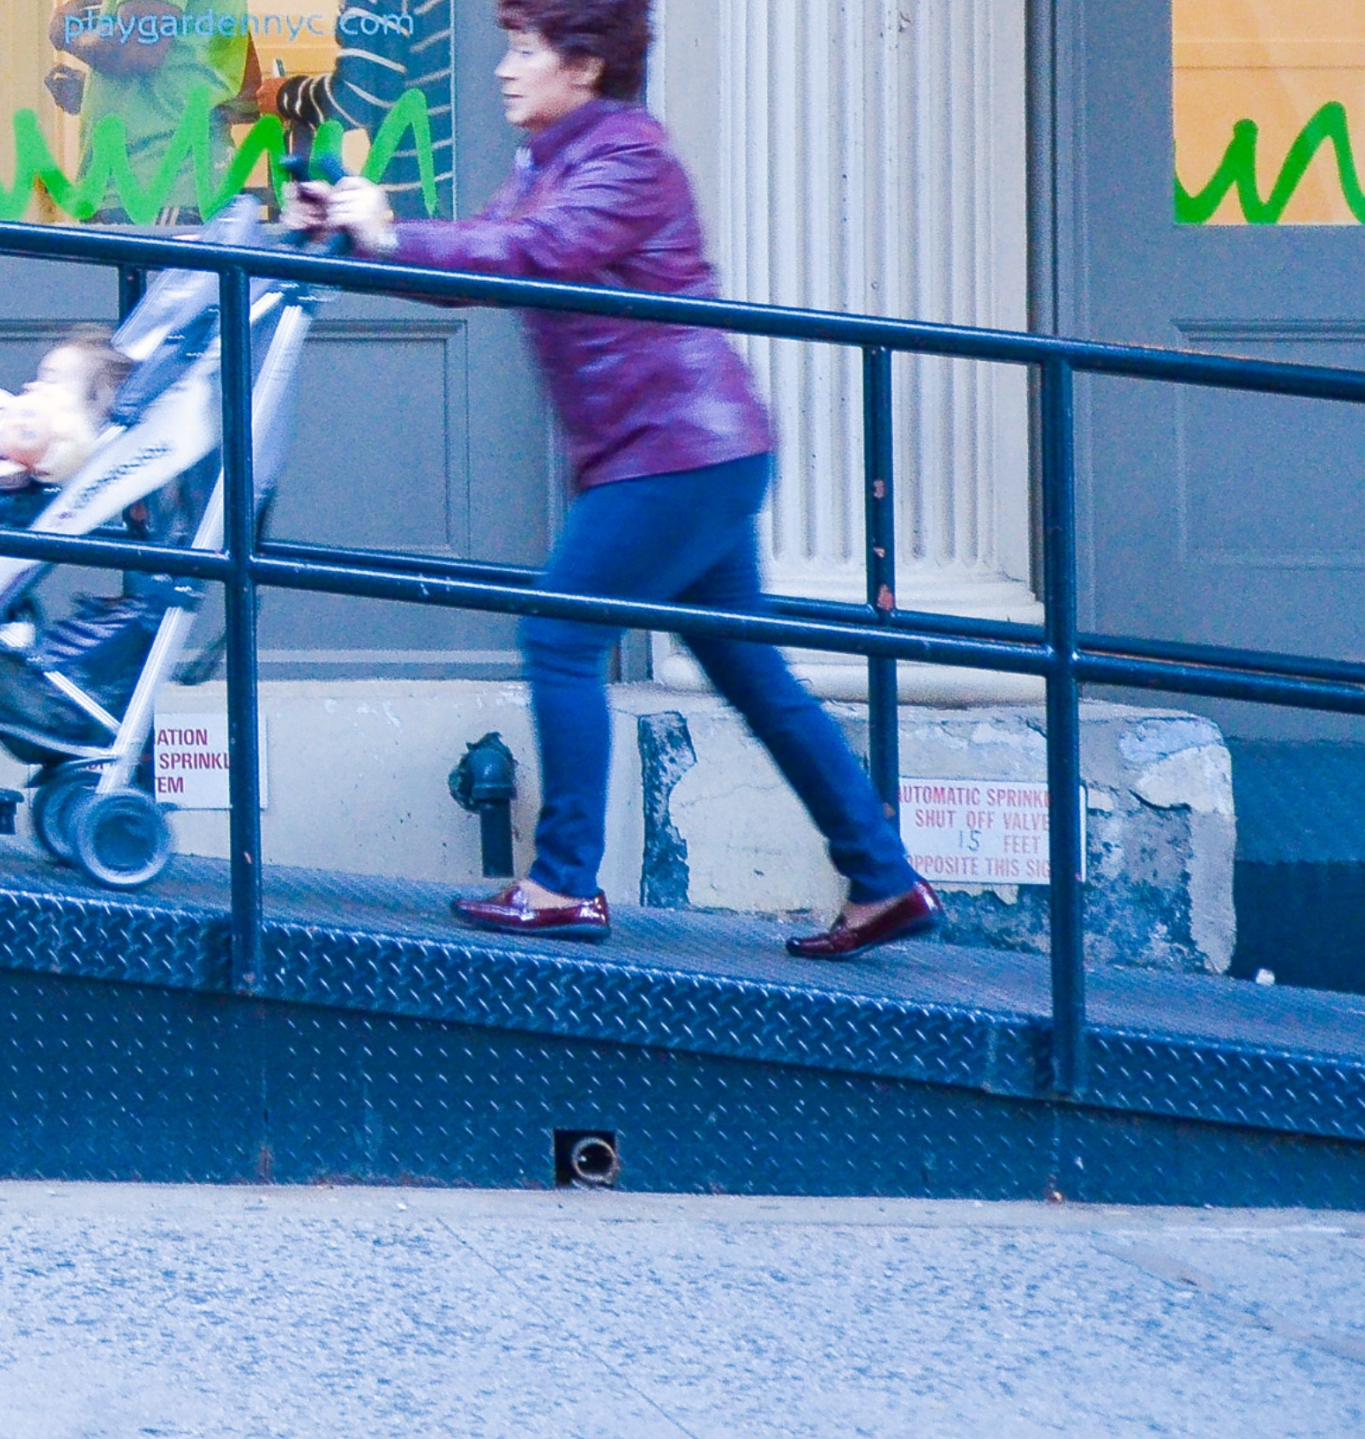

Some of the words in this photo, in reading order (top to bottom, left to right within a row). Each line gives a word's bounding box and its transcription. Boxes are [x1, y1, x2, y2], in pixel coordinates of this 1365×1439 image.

[155, 729, 208, 746] ATION
[159, 753, 230, 770] SPRINKL
[987, 789, 1051, 808] SPRINK
[915, 809, 957, 828] SHUT
[966, 811, 995, 830] OFF
[1003, 812, 1050, 831] VALVE
[1003, 835, 1041, 854] FEET
[987, 858, 1020, 877] THIS
[1026, 859, 1051, 879] SIG
